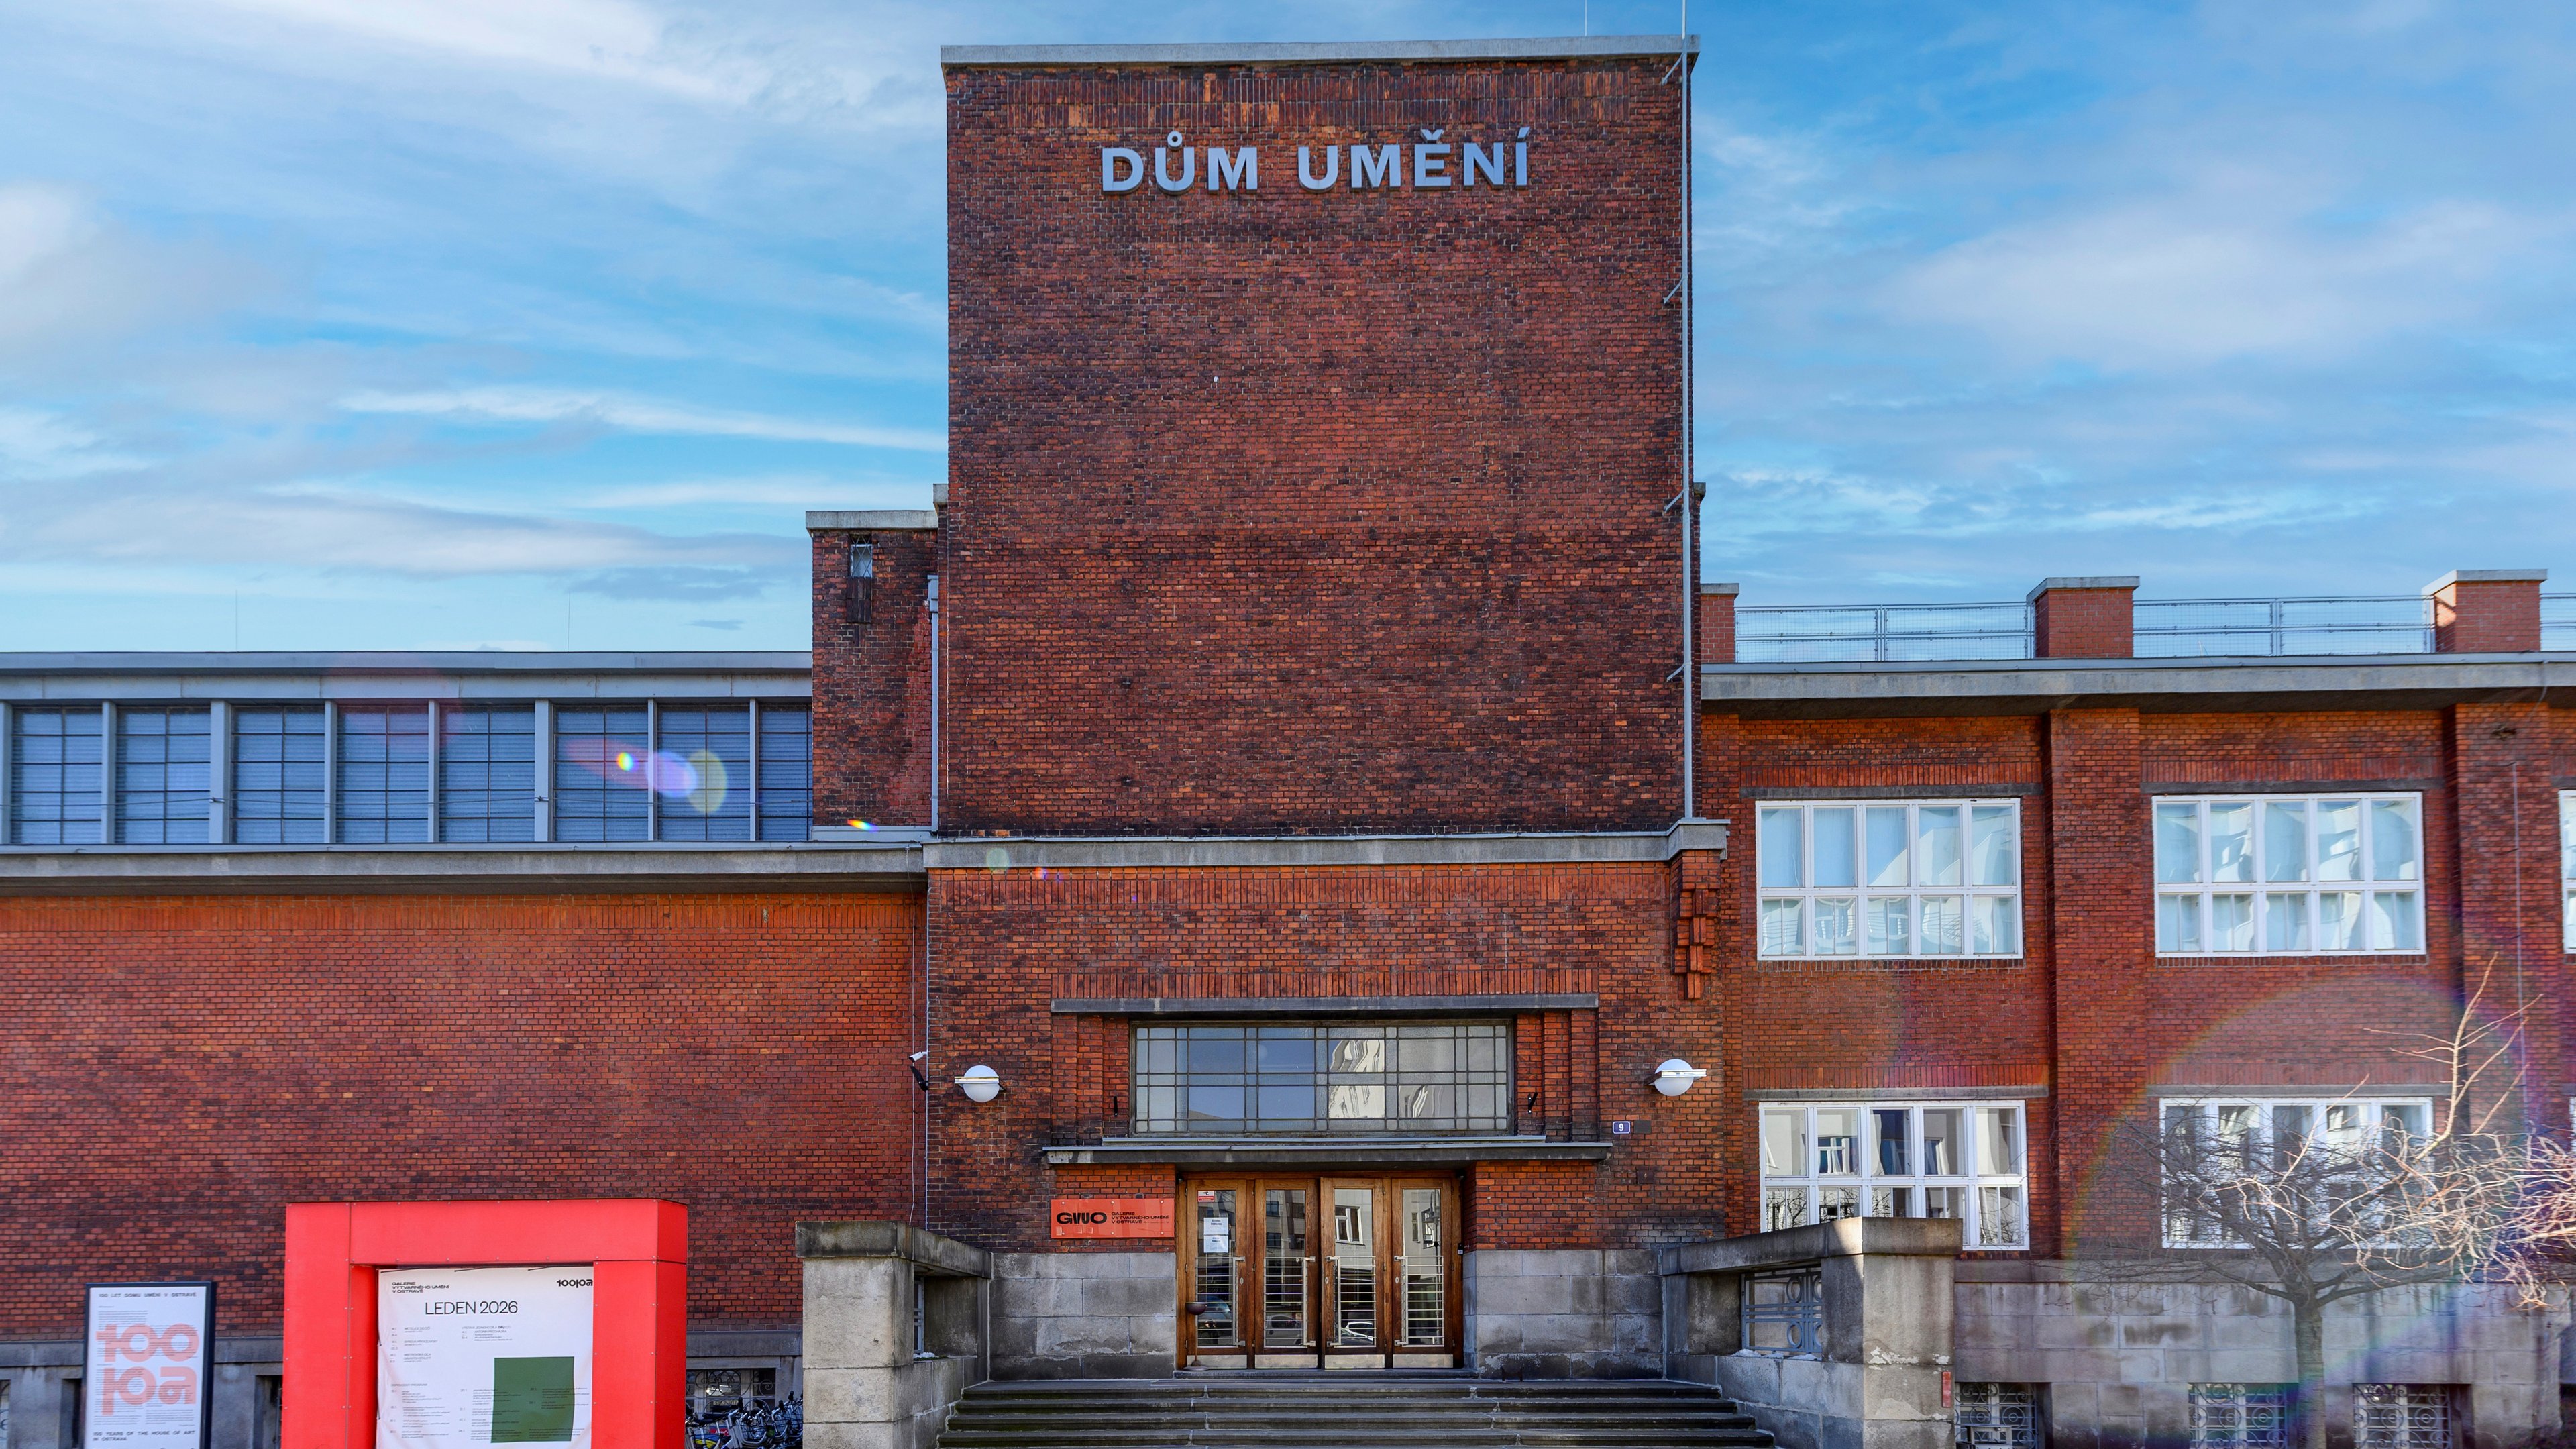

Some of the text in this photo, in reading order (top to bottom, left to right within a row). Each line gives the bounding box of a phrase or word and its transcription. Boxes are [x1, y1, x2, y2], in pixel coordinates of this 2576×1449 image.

[1102, 127, 1531, 194] DŮM UMĚNÍ
[1619, 1123, 1624, 1132] 9
[425, 1301, 518, 1315] LEDEN 2026
[96, 1324, 199, 1362] 100
